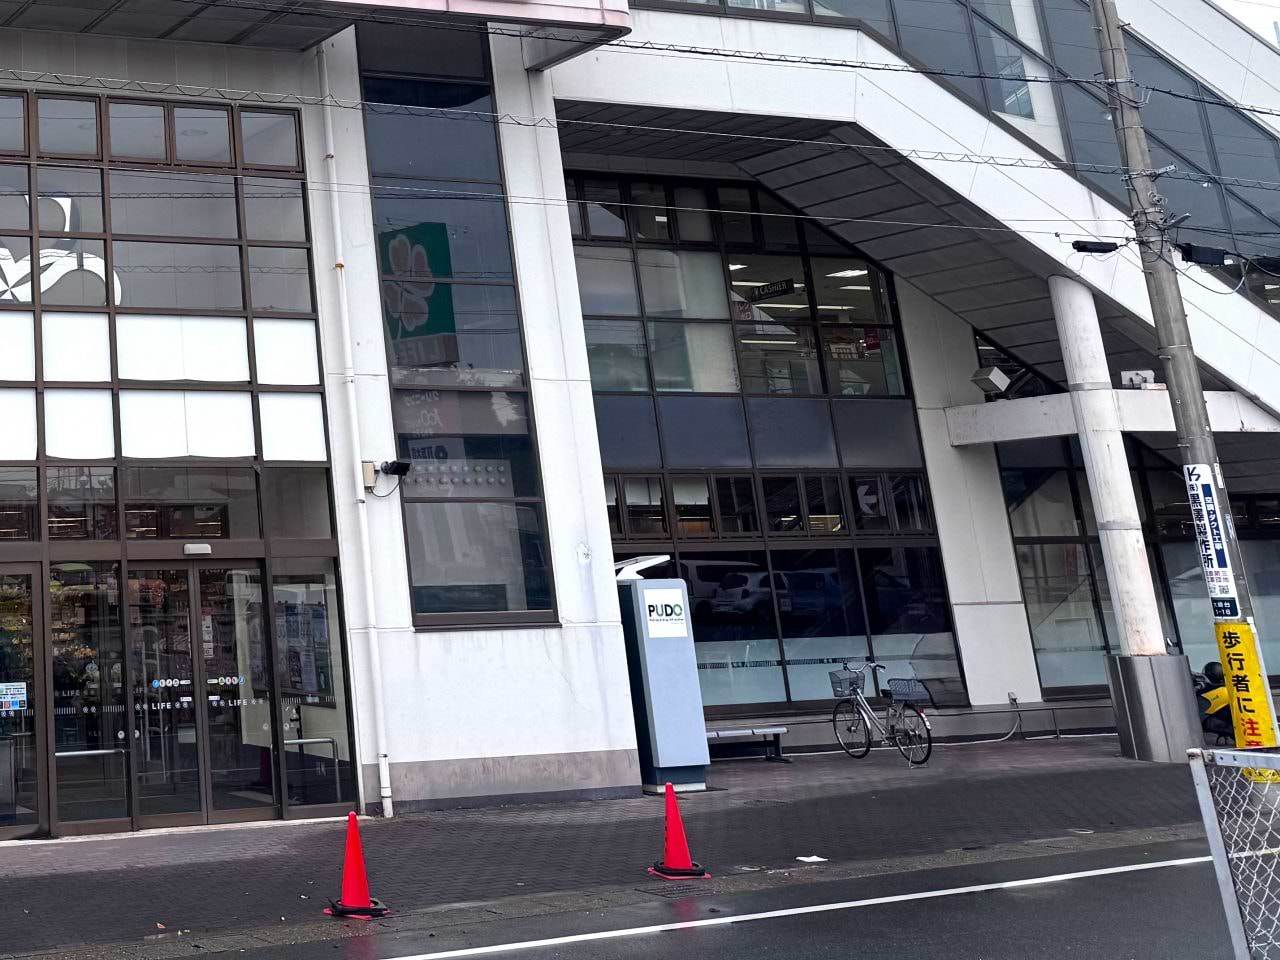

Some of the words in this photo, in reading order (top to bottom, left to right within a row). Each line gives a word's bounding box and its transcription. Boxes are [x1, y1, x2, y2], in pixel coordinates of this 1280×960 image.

[759, 281, 787, 295] CASHIER
[648, 603, 683, 617] PUDO
[152, 702, 172, 710] LIFE
